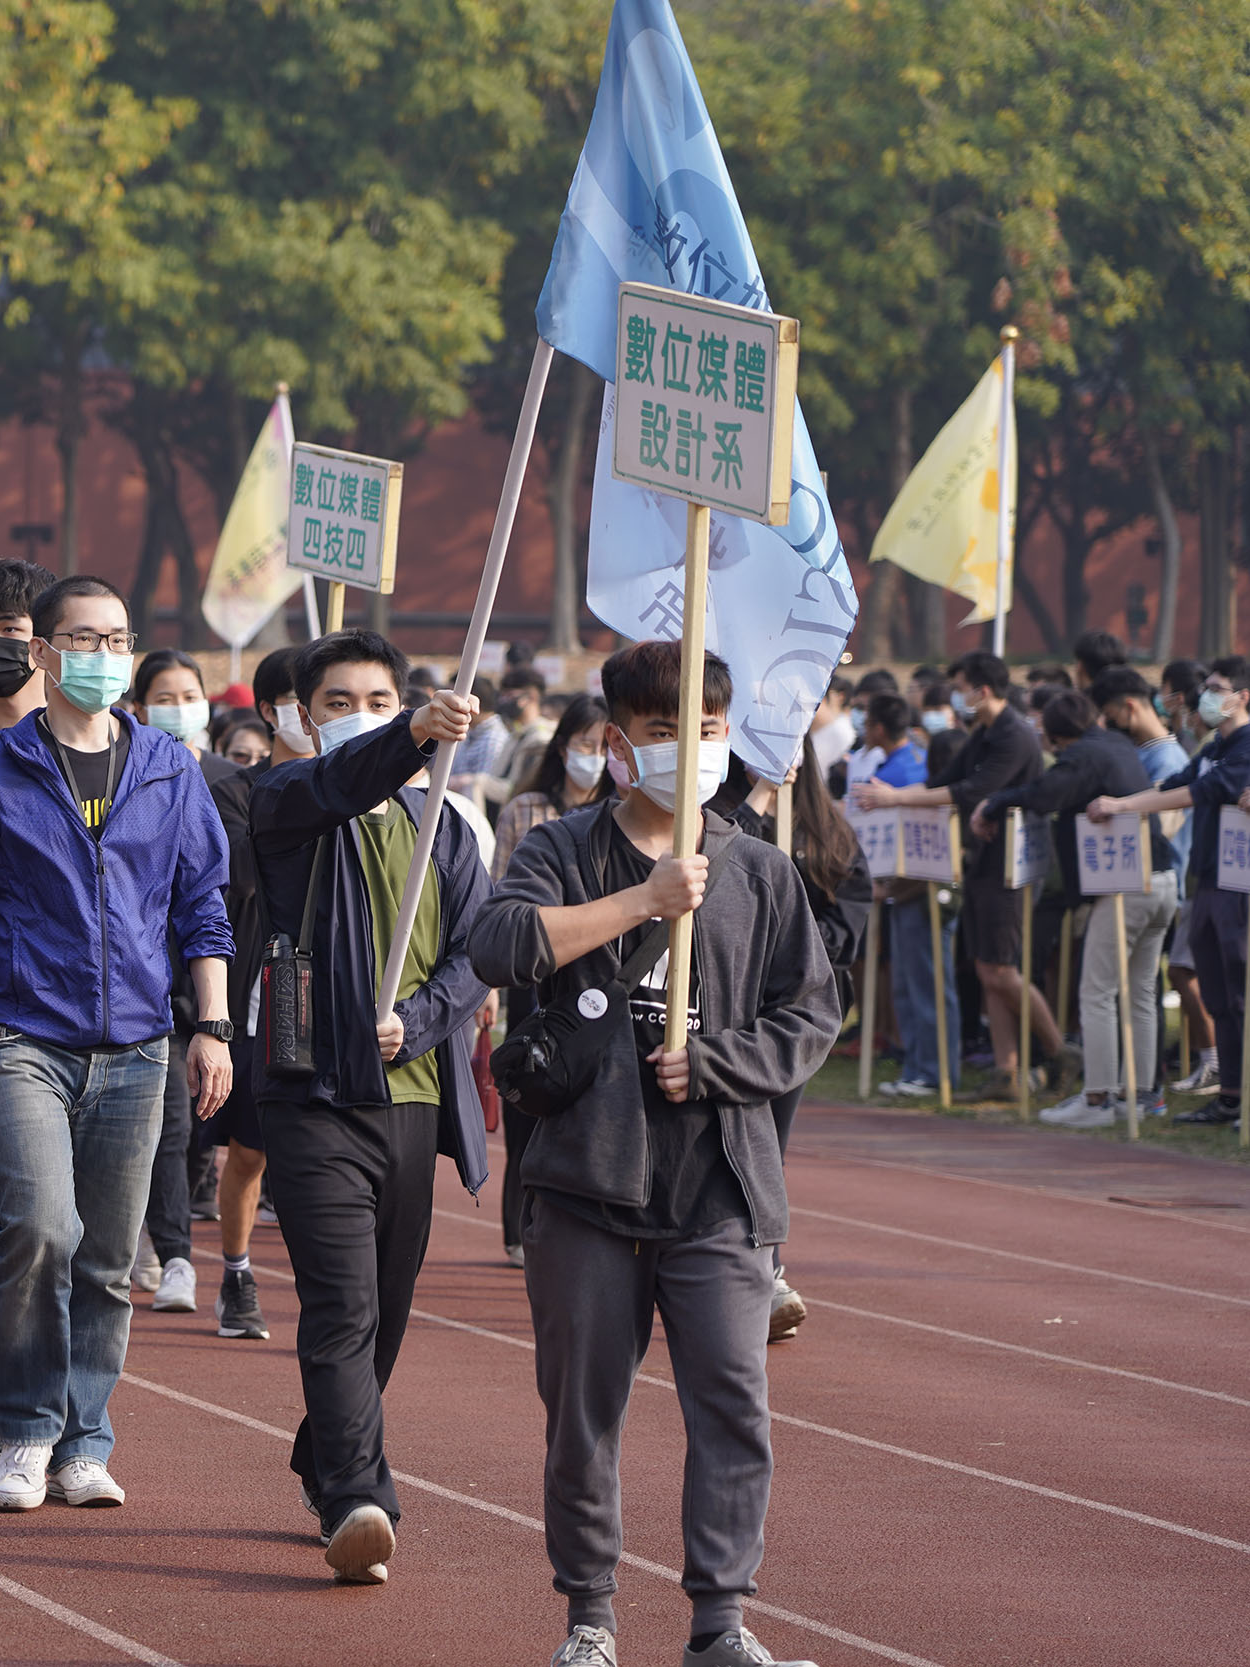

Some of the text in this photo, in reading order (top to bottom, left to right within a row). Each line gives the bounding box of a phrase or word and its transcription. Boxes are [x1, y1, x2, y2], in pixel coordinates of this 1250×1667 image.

[625, 314, 766, 414] 數位媒體
[639, 399, 743, 490] 設計系
[293, 462, 383, 523] 數位媒體
[302, 517, 366, 571] 四技四
[276, 964, 297, 1063] SAHARA
